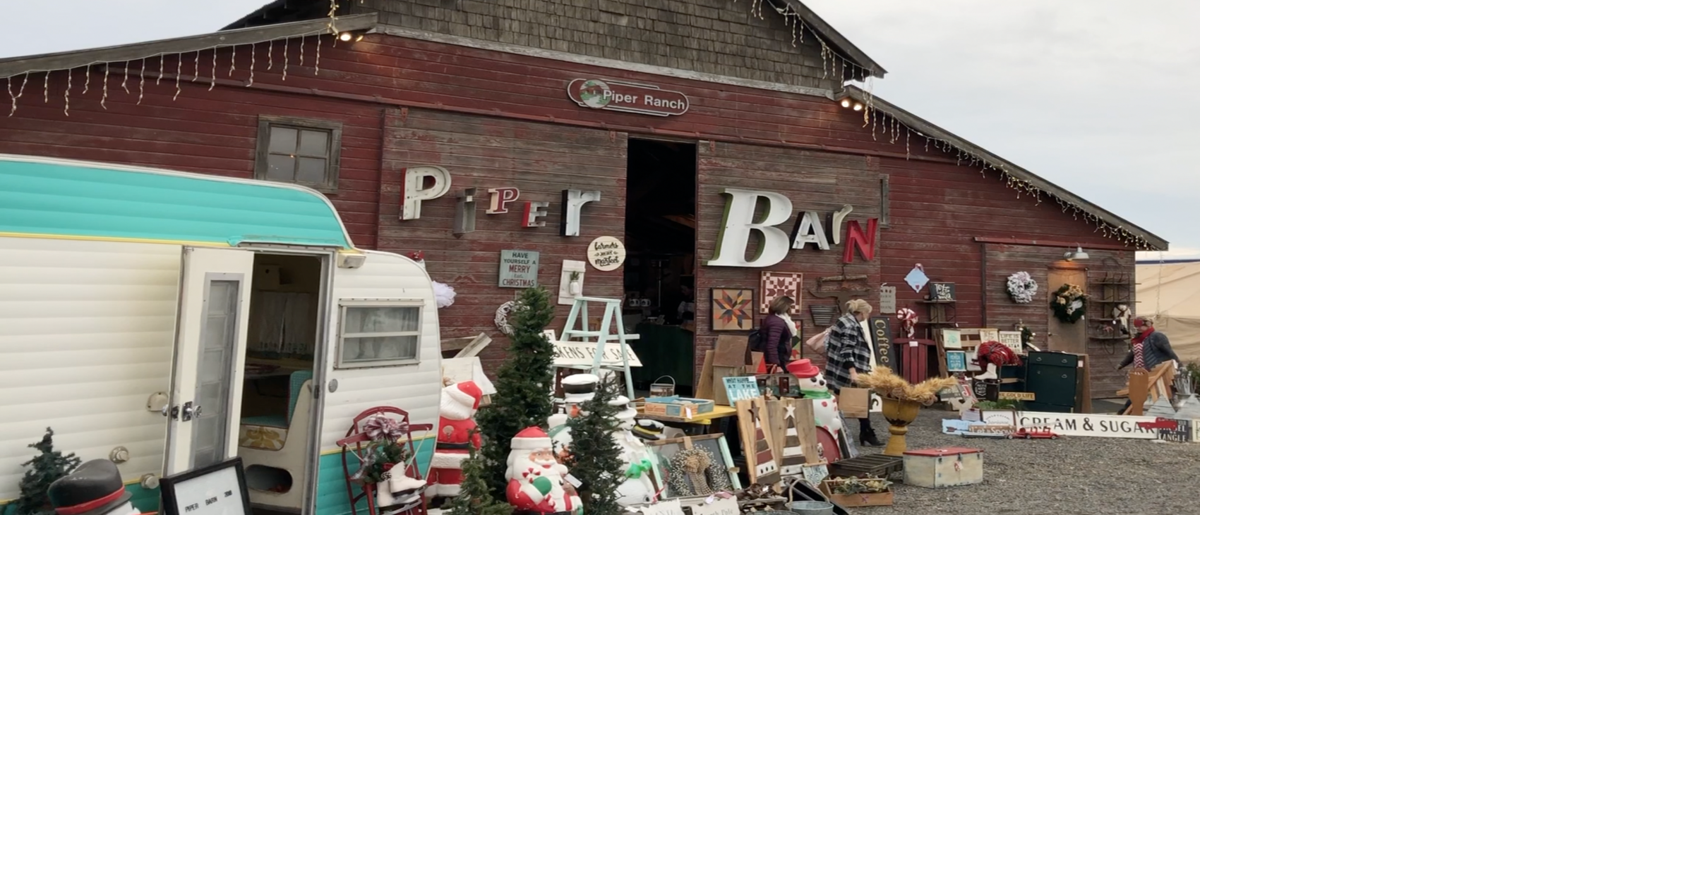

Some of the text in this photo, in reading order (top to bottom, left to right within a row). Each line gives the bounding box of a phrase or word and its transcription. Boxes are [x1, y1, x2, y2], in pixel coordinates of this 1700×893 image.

[603, 89, 686, 110] Piper Ranch
[508, 264, 531, 274] MERRY
[502, 278, 535, 287] CHRISTMAS
[874, 319, 890, 363] Coffee
[610, 347, 636, 361] SAE
[728, 388, 758, 401] LAKE
[1020, 416, 1077, 432] CREAM
[1082, 417, 1094, 432] &
[184, 502, 199, 513] PIPER
